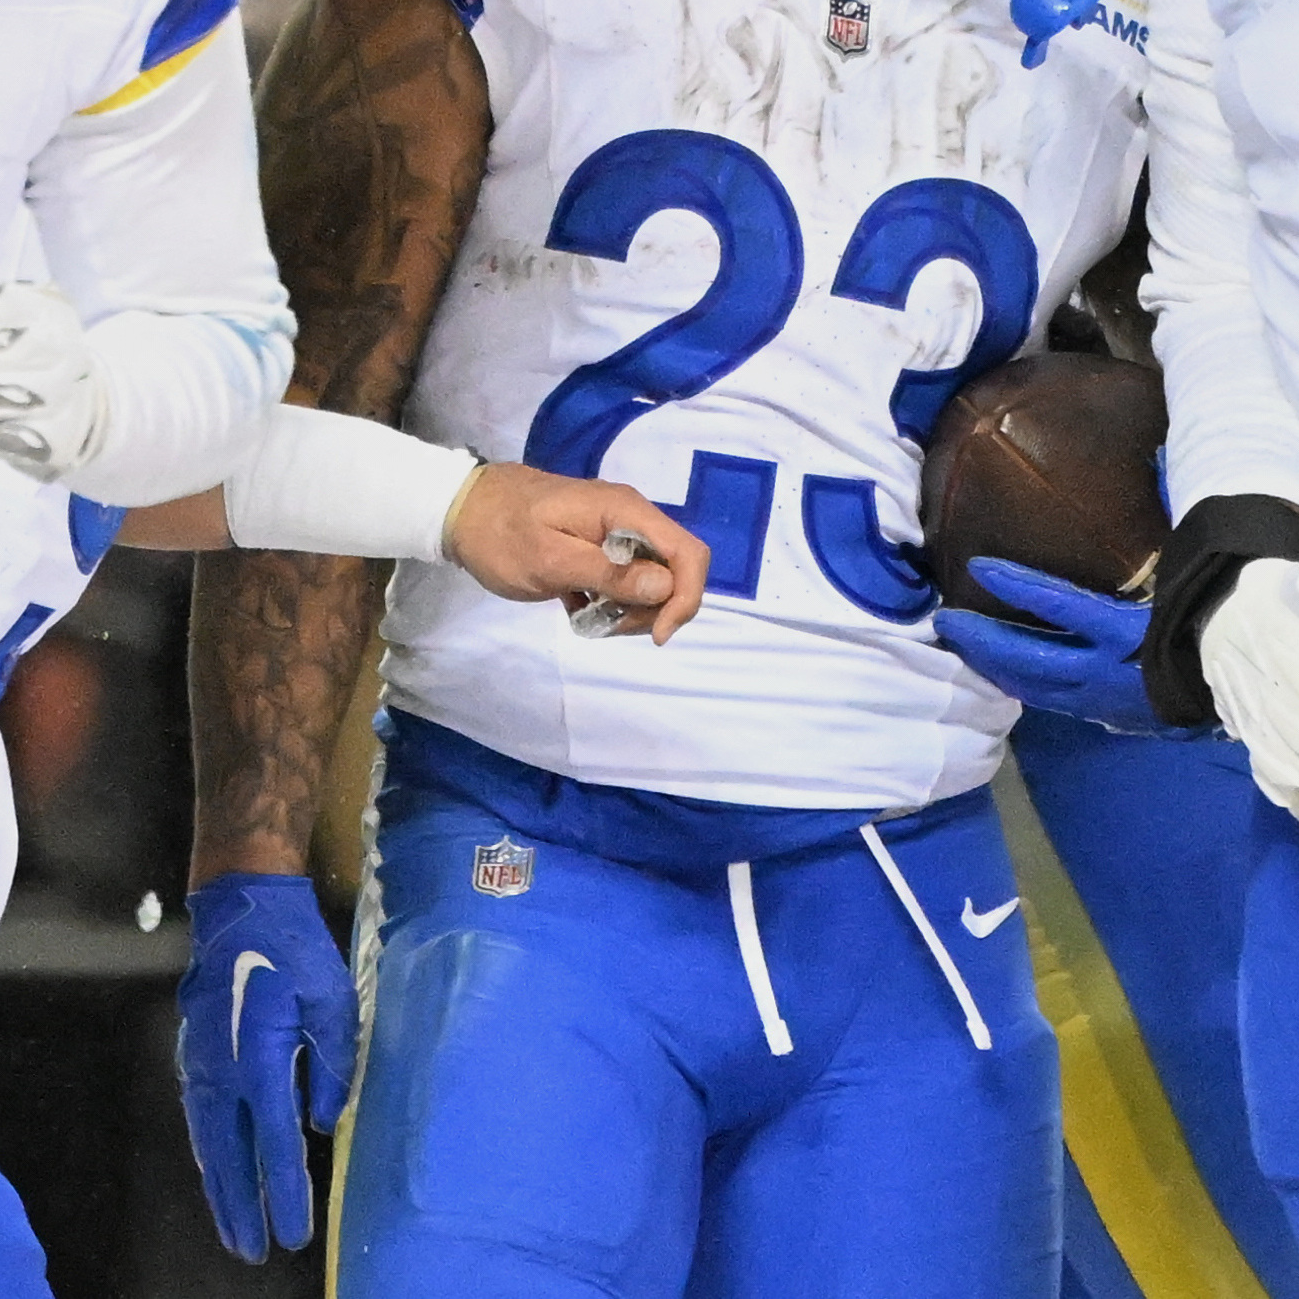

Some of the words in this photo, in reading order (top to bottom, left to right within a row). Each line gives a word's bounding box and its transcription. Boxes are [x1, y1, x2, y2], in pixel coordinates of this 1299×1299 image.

[830, 16, 866, 48] NFL
[1070, 3, 1150, 57] AMS
[523, 128, 1039, 626] 23
[482, 864, 523, 889] NFL
